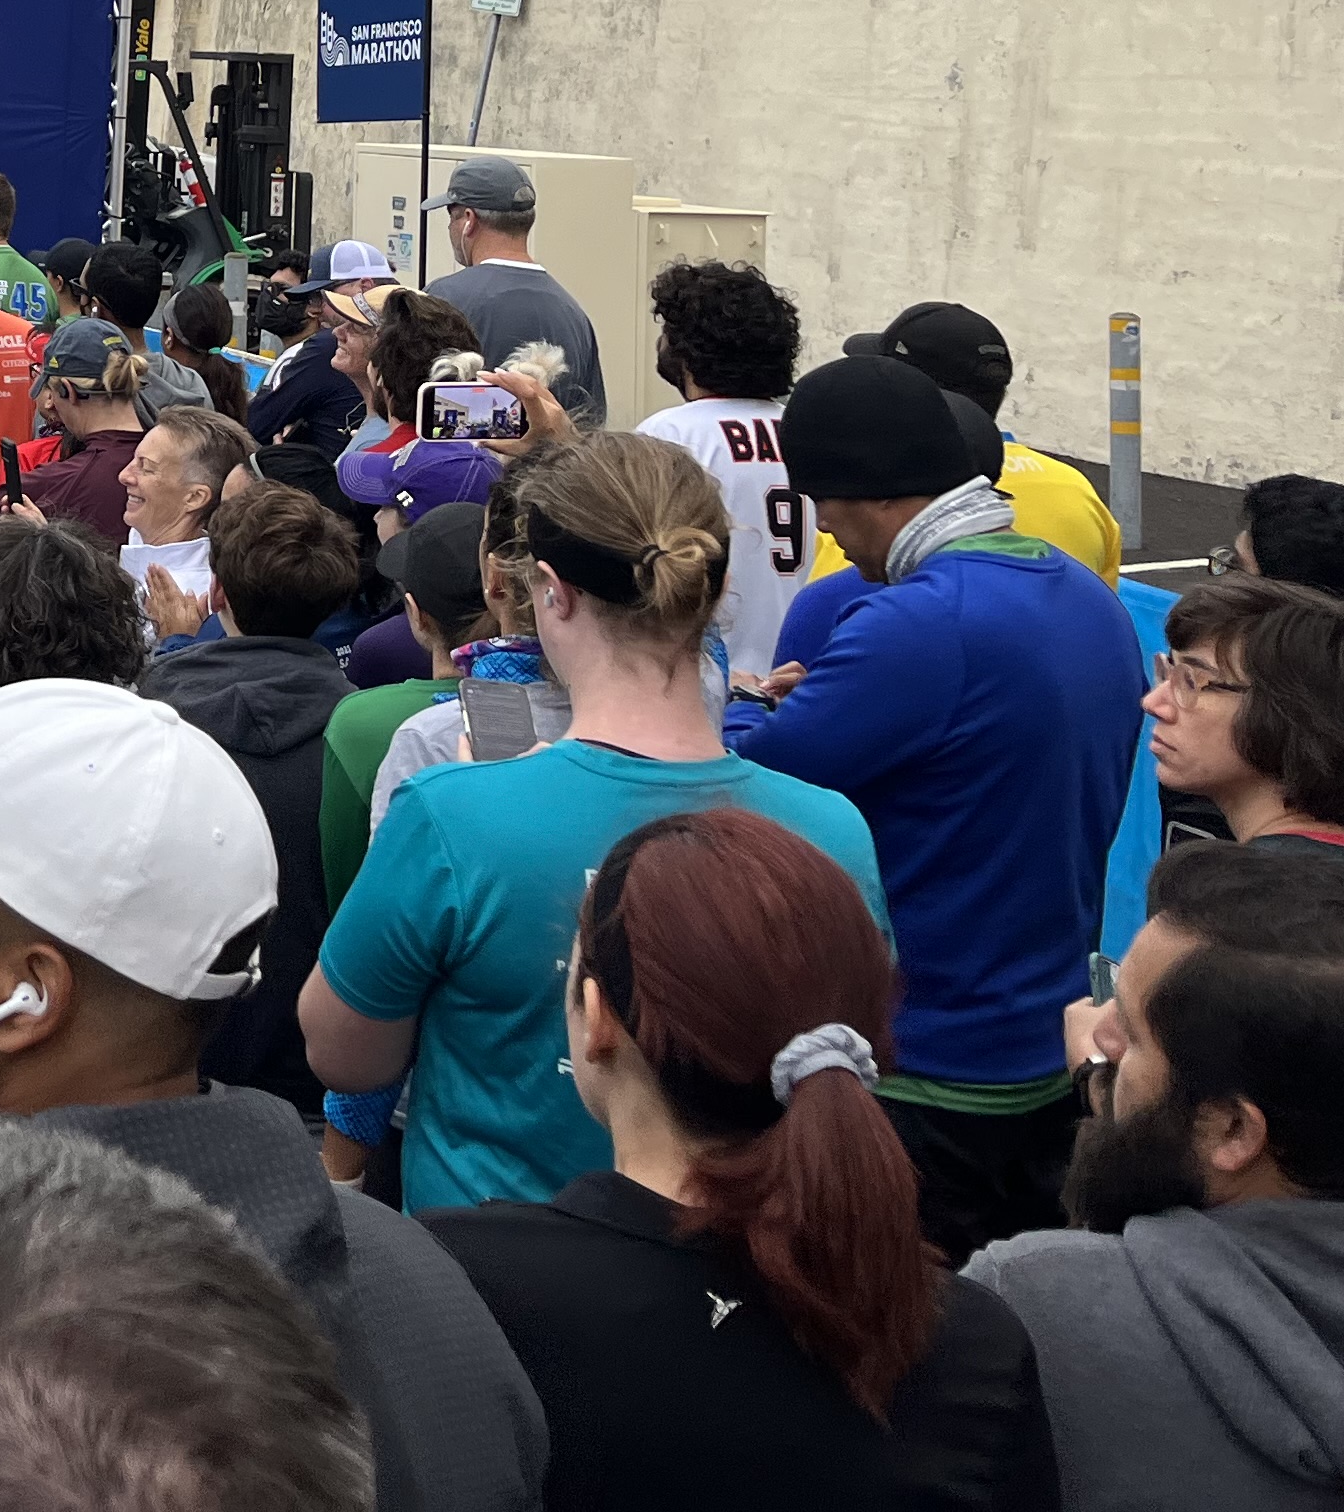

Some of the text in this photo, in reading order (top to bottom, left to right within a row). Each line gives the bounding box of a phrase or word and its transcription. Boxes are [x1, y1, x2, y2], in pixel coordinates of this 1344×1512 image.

[135, 18, 151, 53] Yale
[352, 19, 422, 41] SAN FRANCISCO
[351, 38, 422, 65] MARATHON
[9, 281, 48, 321] 45
